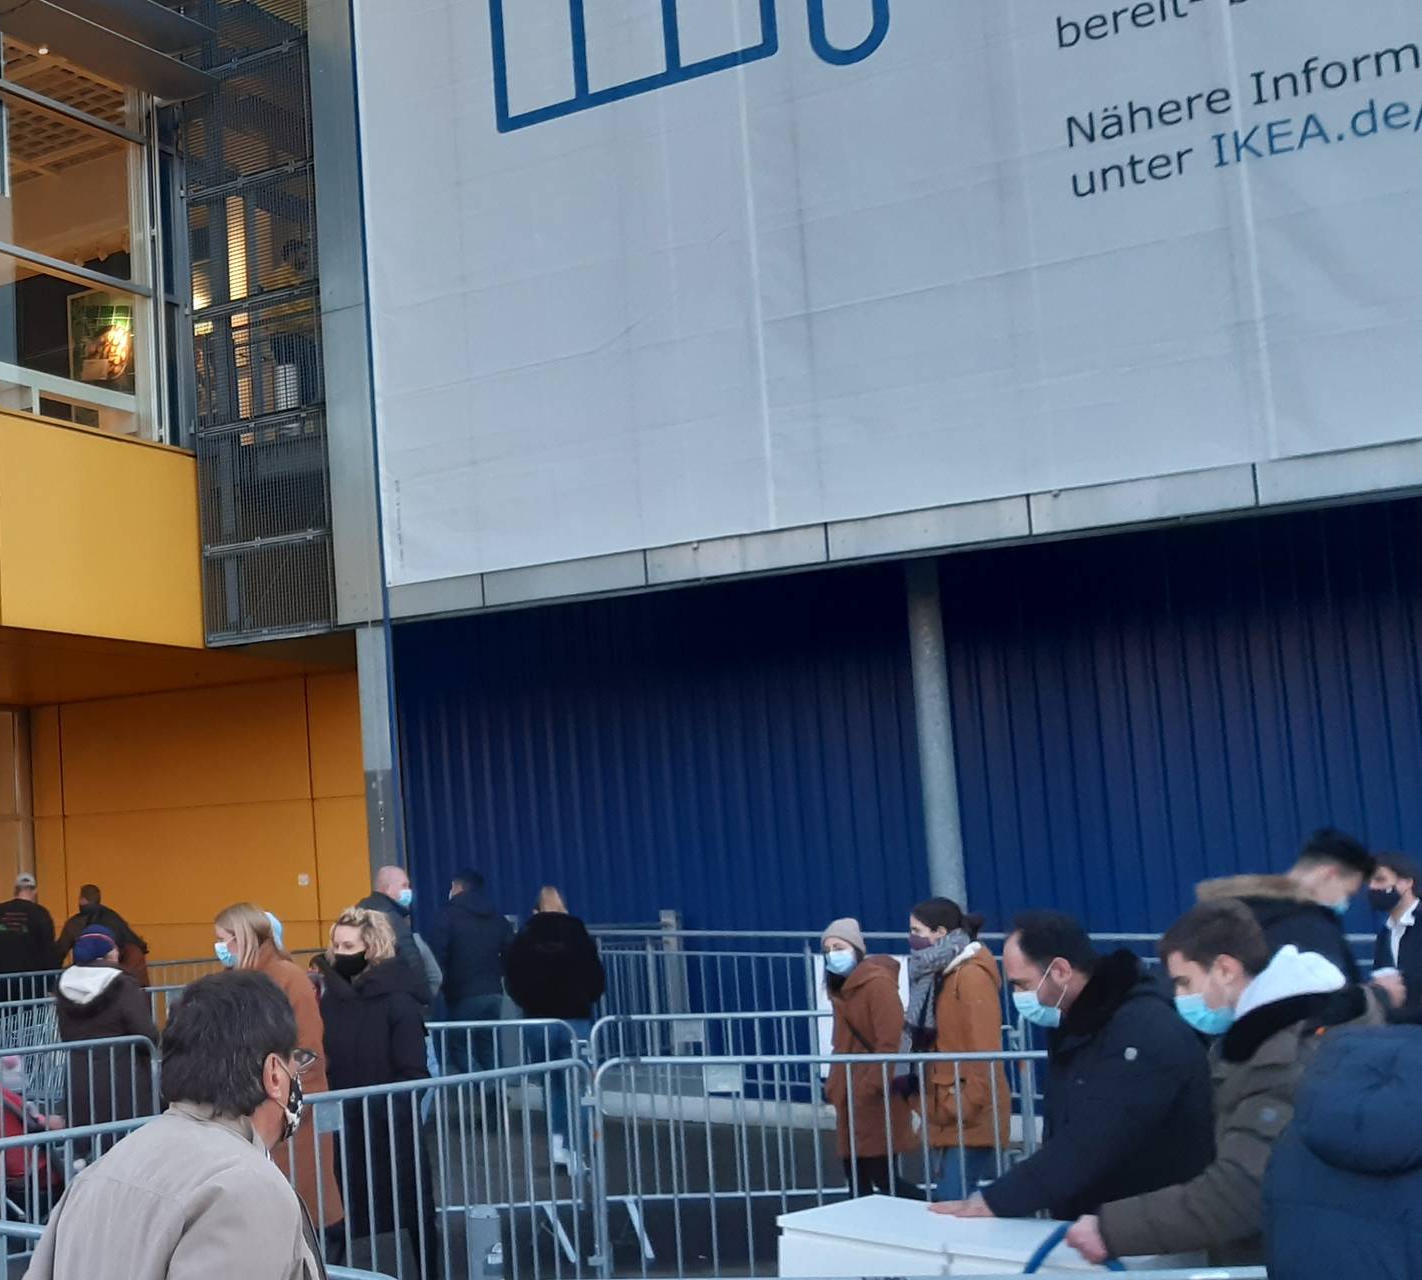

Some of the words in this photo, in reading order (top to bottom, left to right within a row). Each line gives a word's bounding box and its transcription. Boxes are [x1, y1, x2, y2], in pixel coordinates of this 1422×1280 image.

[1067, 87, 1231, 147] Nähere
[1250, 43, 1420, 105] Inform
[1072, 144, 1193, 198] unter
